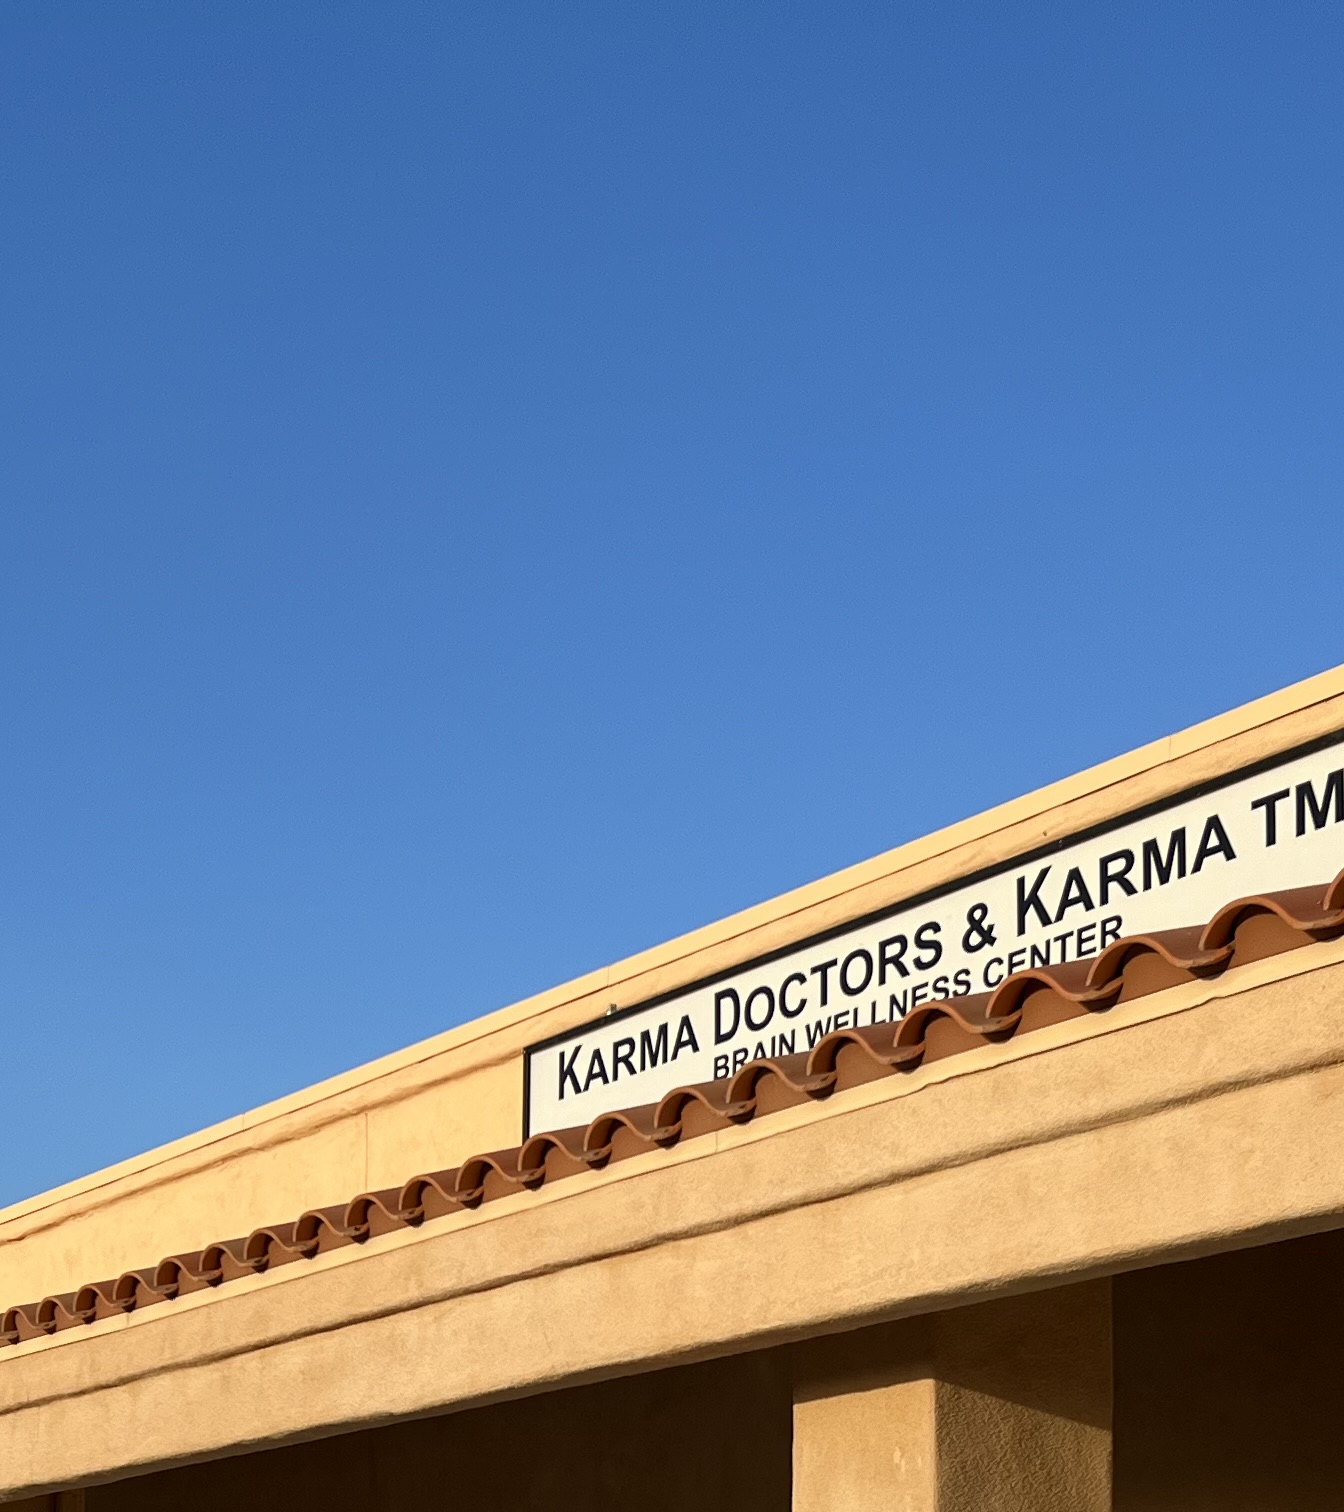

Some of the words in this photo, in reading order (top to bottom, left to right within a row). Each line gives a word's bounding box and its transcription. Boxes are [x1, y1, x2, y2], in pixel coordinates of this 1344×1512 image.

[558, 1014, 700, 1101] KARMA
[714, 921, 943, 1046] DOCTORS
[961, 902, 997, 954] &
[1016, 813, 1237, 937] KARMA
[713, 1029, 795, 1080] BRAIN
[983, 915, 1123, 988] CENTER
